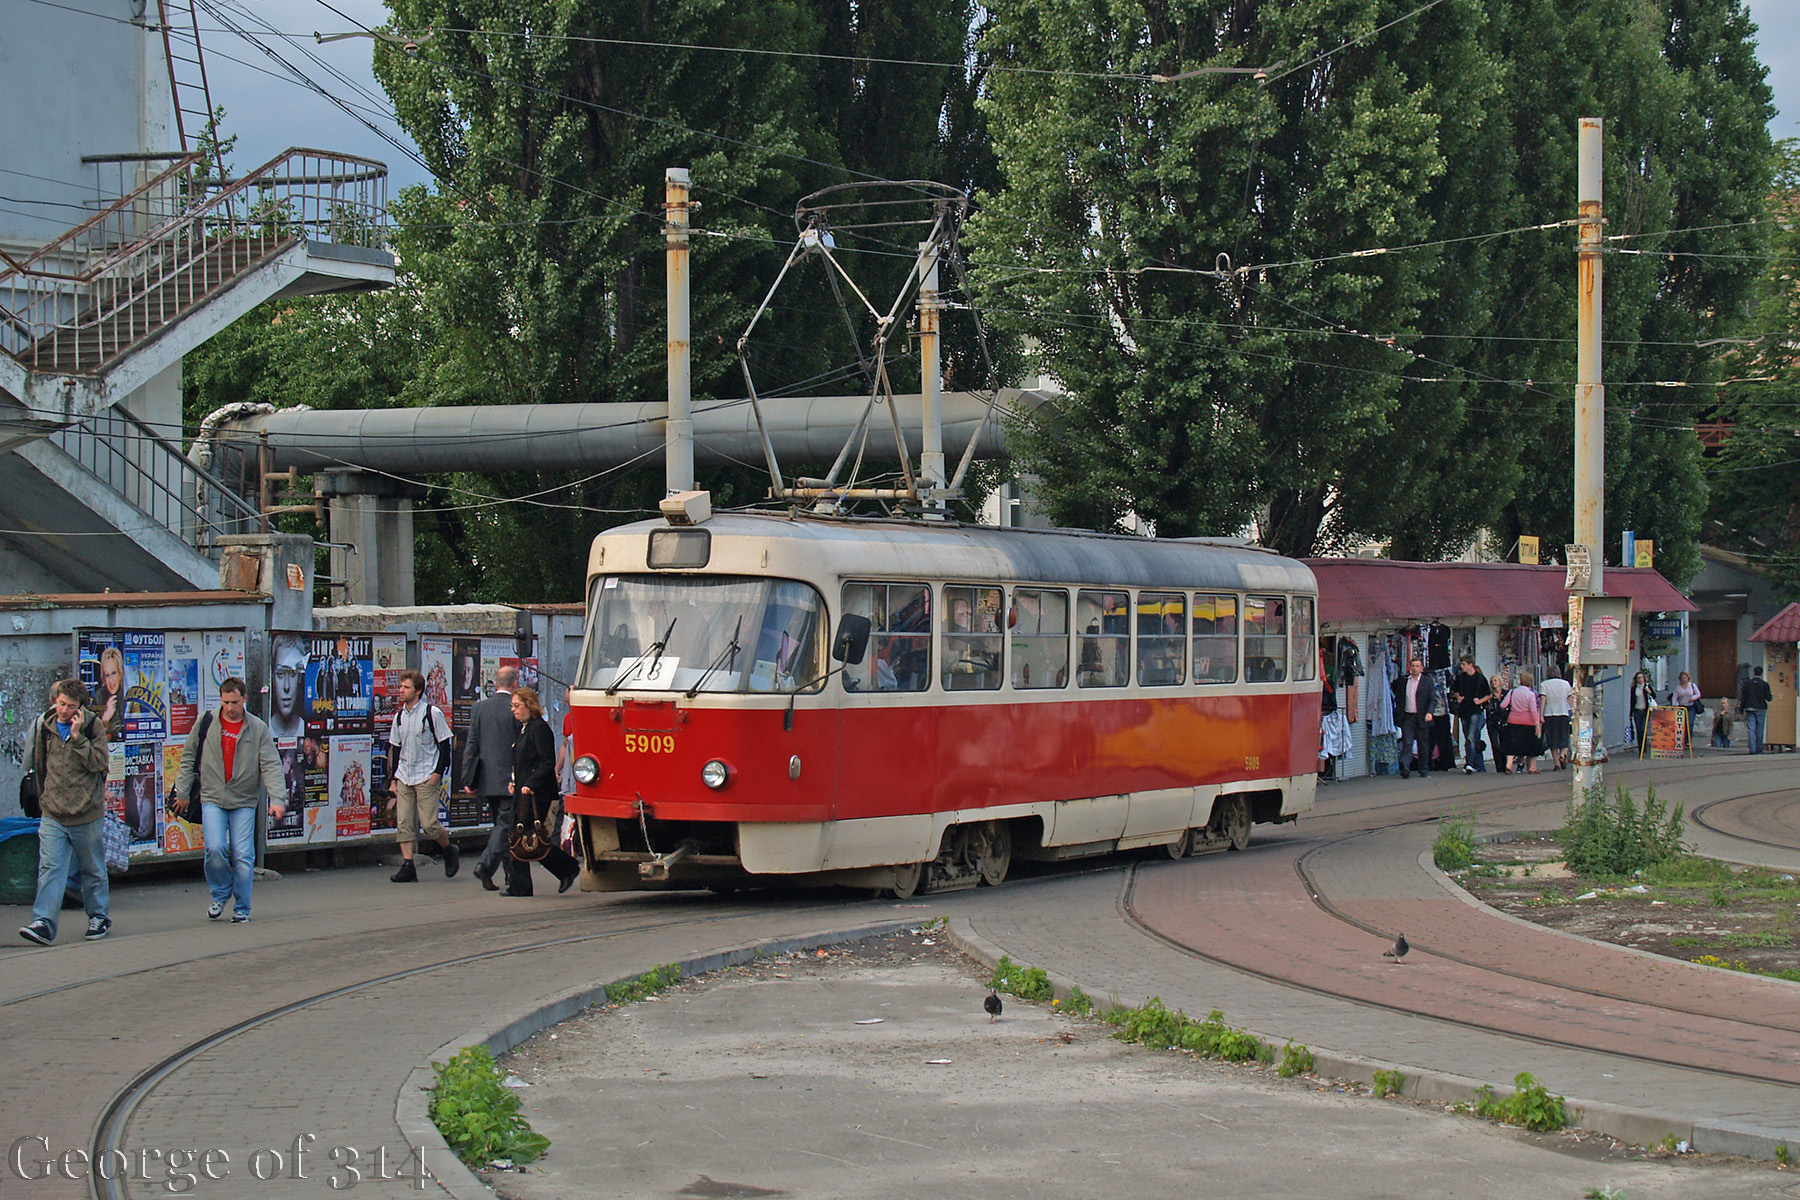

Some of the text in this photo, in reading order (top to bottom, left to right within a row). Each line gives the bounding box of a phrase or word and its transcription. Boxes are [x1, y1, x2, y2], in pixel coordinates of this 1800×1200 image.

[132, 634, 165, 645] ФУТБОЛ
[311, 640, 370, 656] LIMP ZKIT
[1676, 710, 1684, 749] ОПТИКА
[625, 734, 675, 754] 5909
[1244, 756, 1260, 770] 5909
